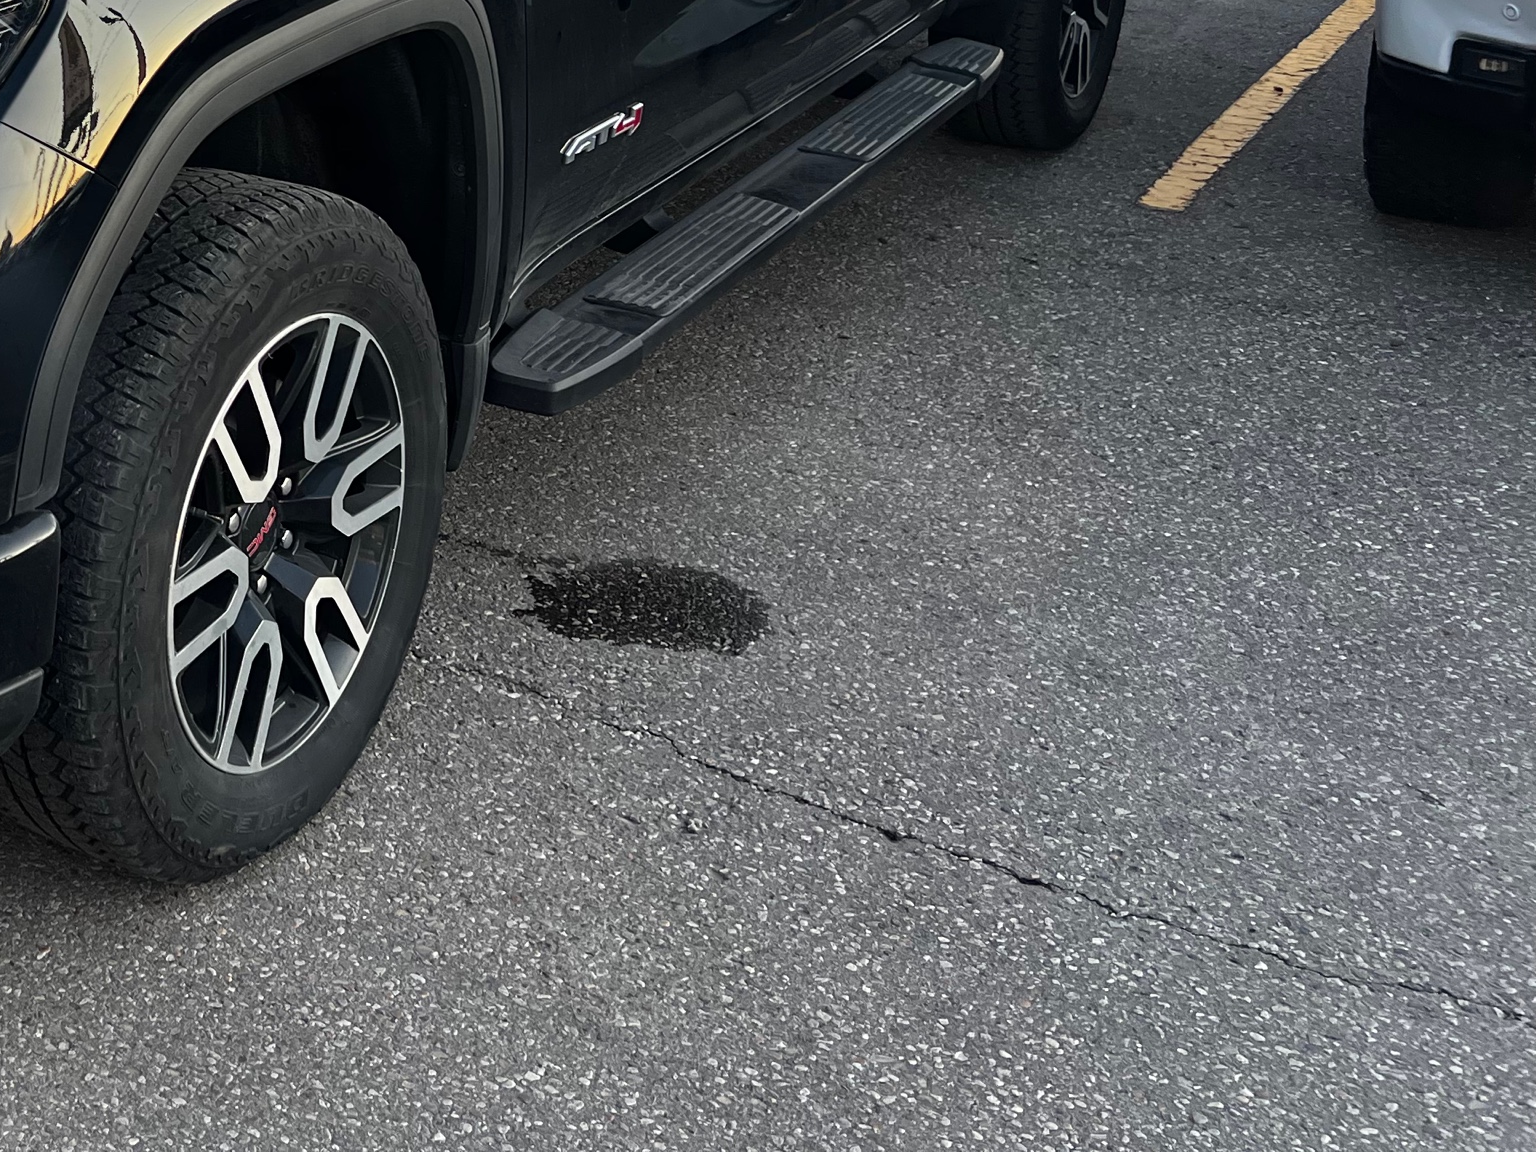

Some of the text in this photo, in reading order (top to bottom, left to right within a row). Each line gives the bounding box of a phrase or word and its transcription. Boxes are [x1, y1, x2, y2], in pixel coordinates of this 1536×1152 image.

[559, 101, 645, 165] AT4
[289, 260, 431, 362] BRIDGESTONE
[246, 506, 277, 558] GMC
[180, 779, 310, 835] DUELER
